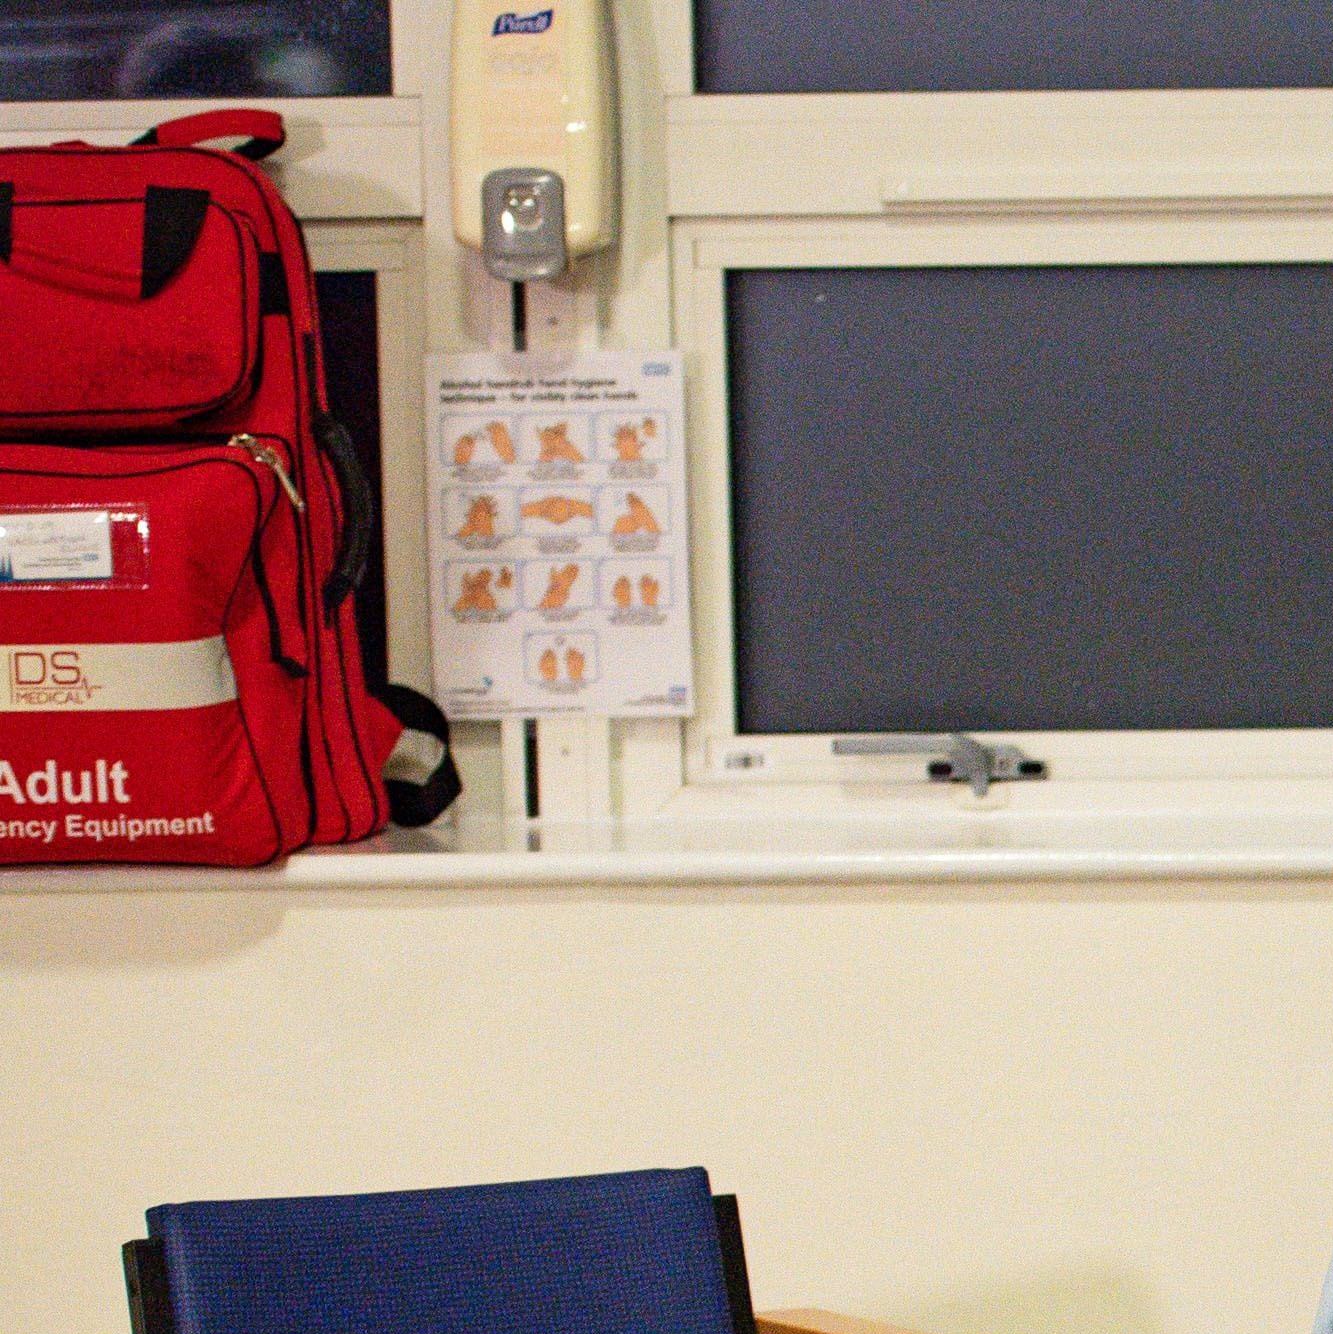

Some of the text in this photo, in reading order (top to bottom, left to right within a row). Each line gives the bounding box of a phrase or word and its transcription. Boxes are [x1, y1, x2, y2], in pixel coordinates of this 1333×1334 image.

[14, 650, 82, 686] DS
[15, 691, 84, 705] MEDICAL
[64, 811, 215, 841] Equipment
